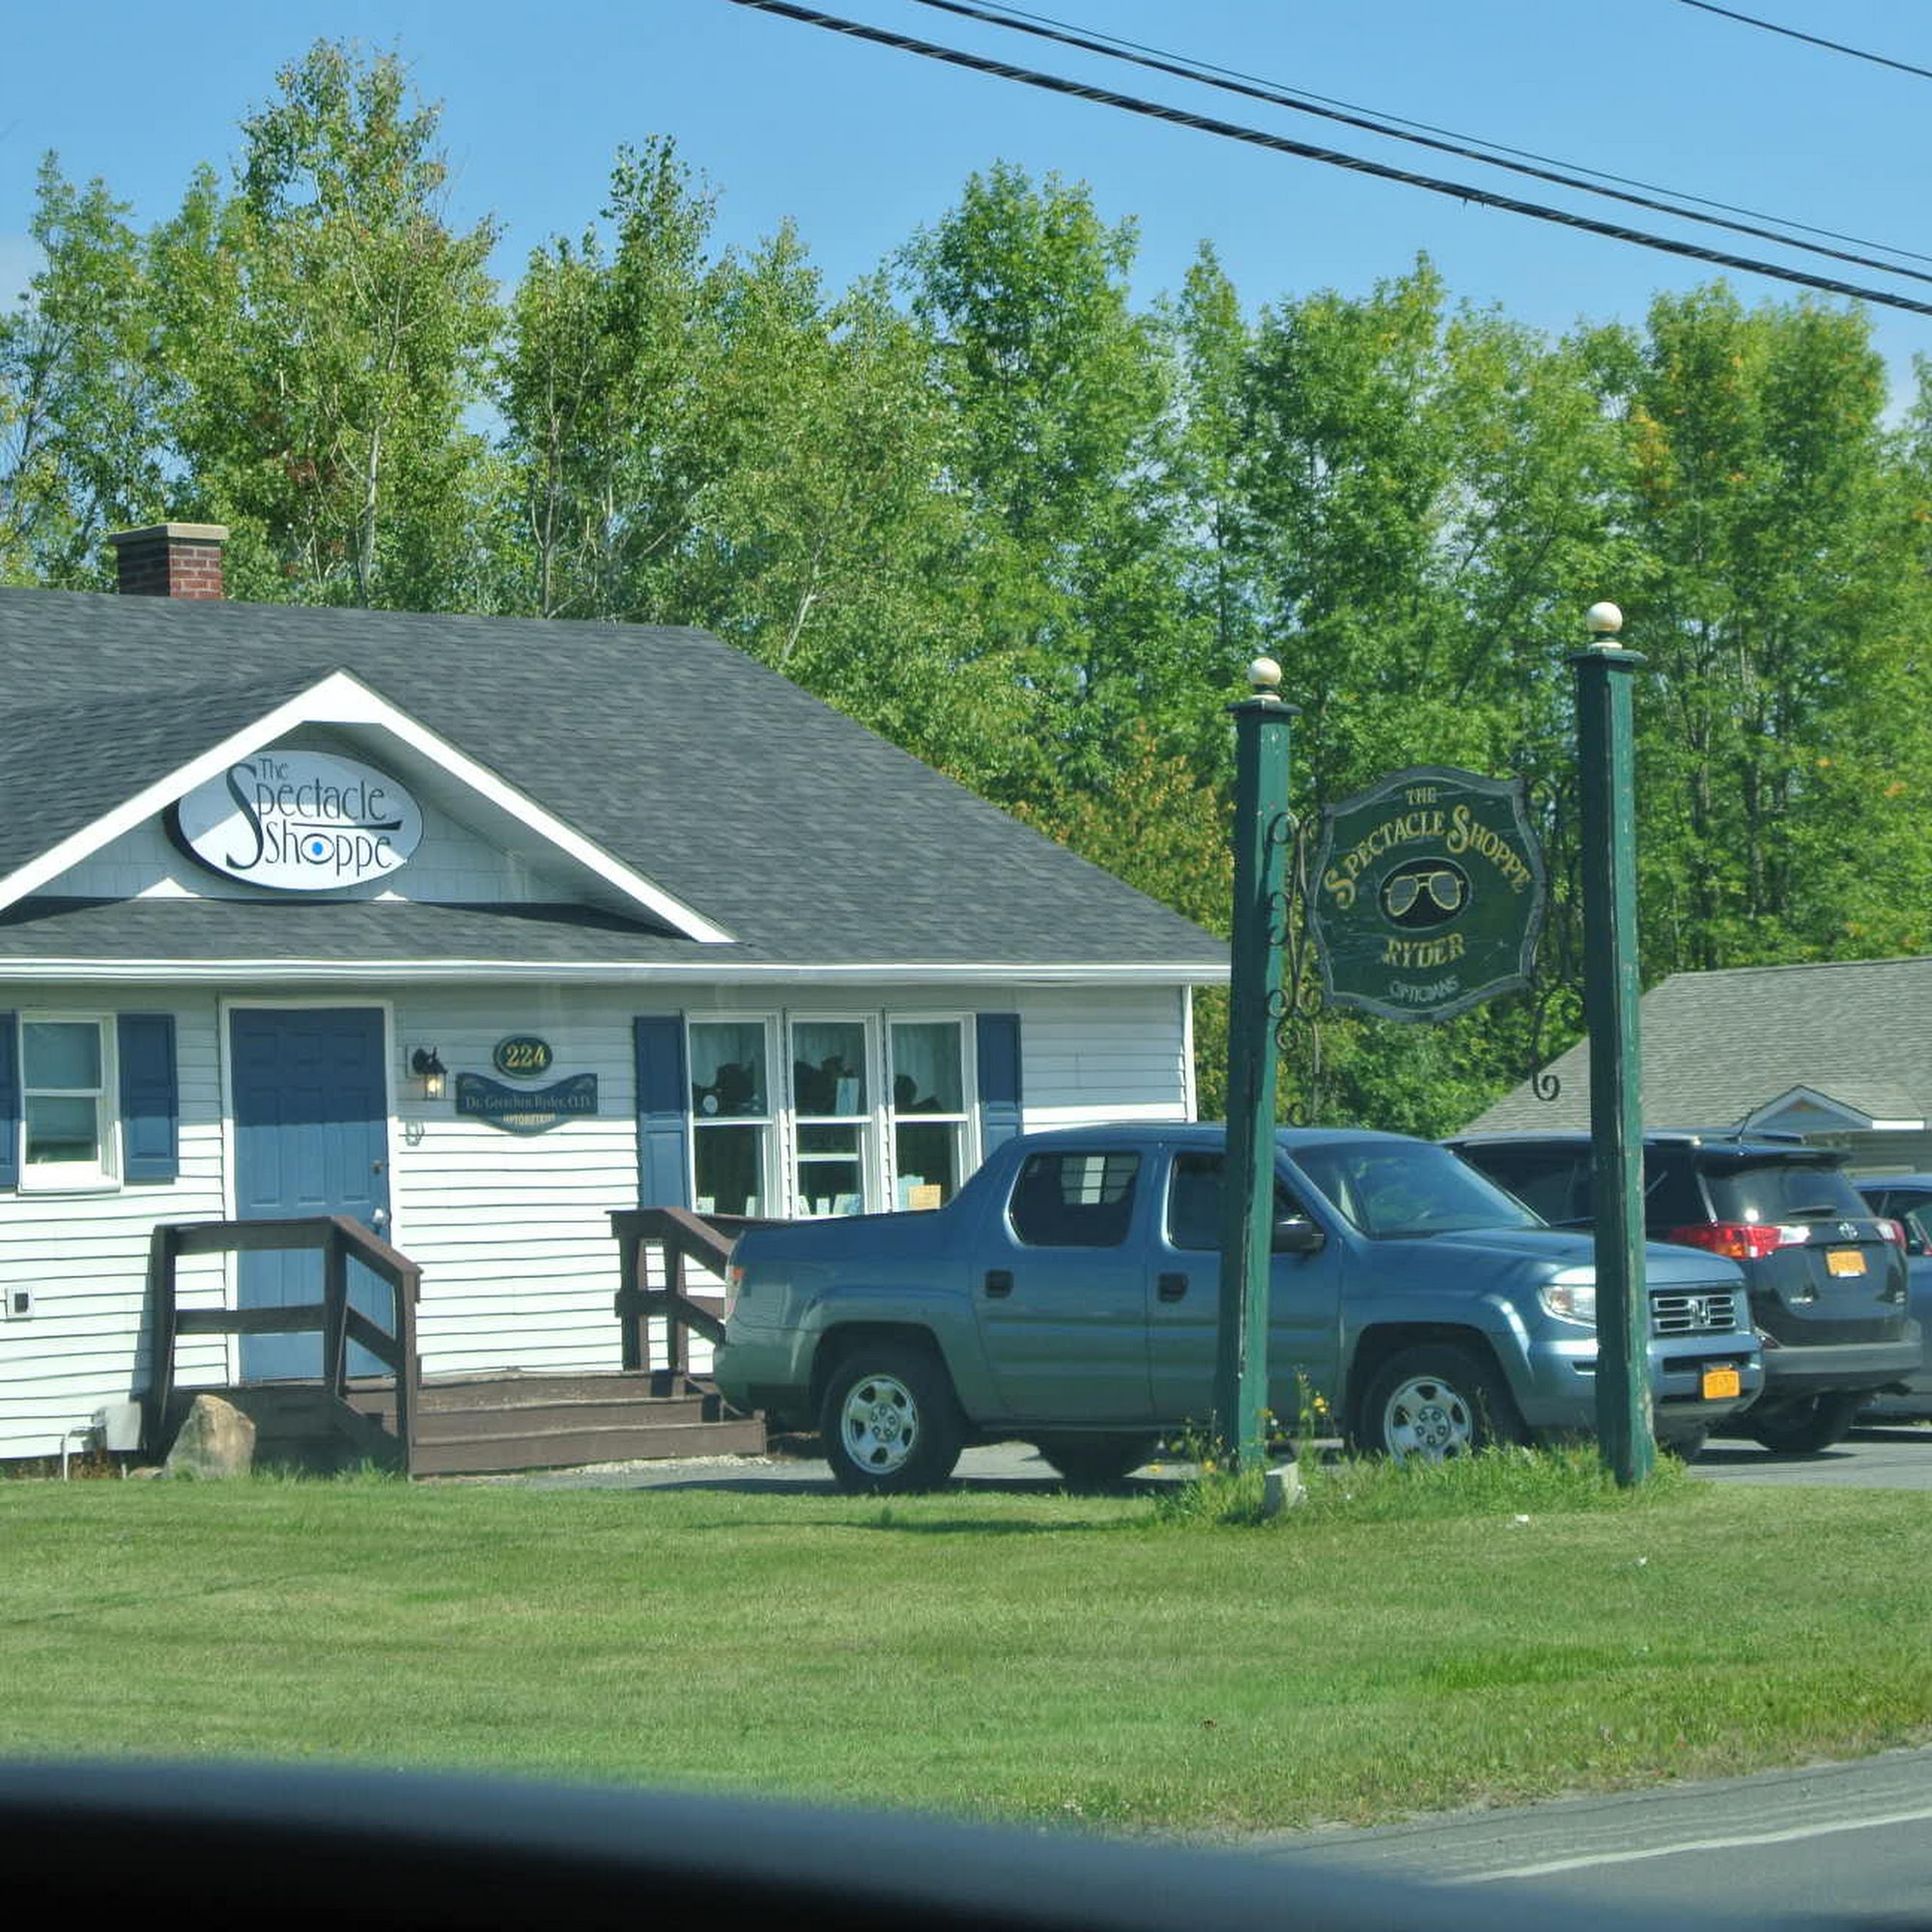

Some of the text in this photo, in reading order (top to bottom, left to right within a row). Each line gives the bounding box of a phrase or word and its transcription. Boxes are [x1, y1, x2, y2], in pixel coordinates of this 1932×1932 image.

[258, 758, 288, 779] The
[1406, 786, 1437, 807] THE
[226, 762, 387, 869] Spectacle
[1323, 805, 1533, 910] SPECTACLE SHOPPE
[1382, 932, 1467, 967] RYDER
[506, 1043, 547, 1067] 224
